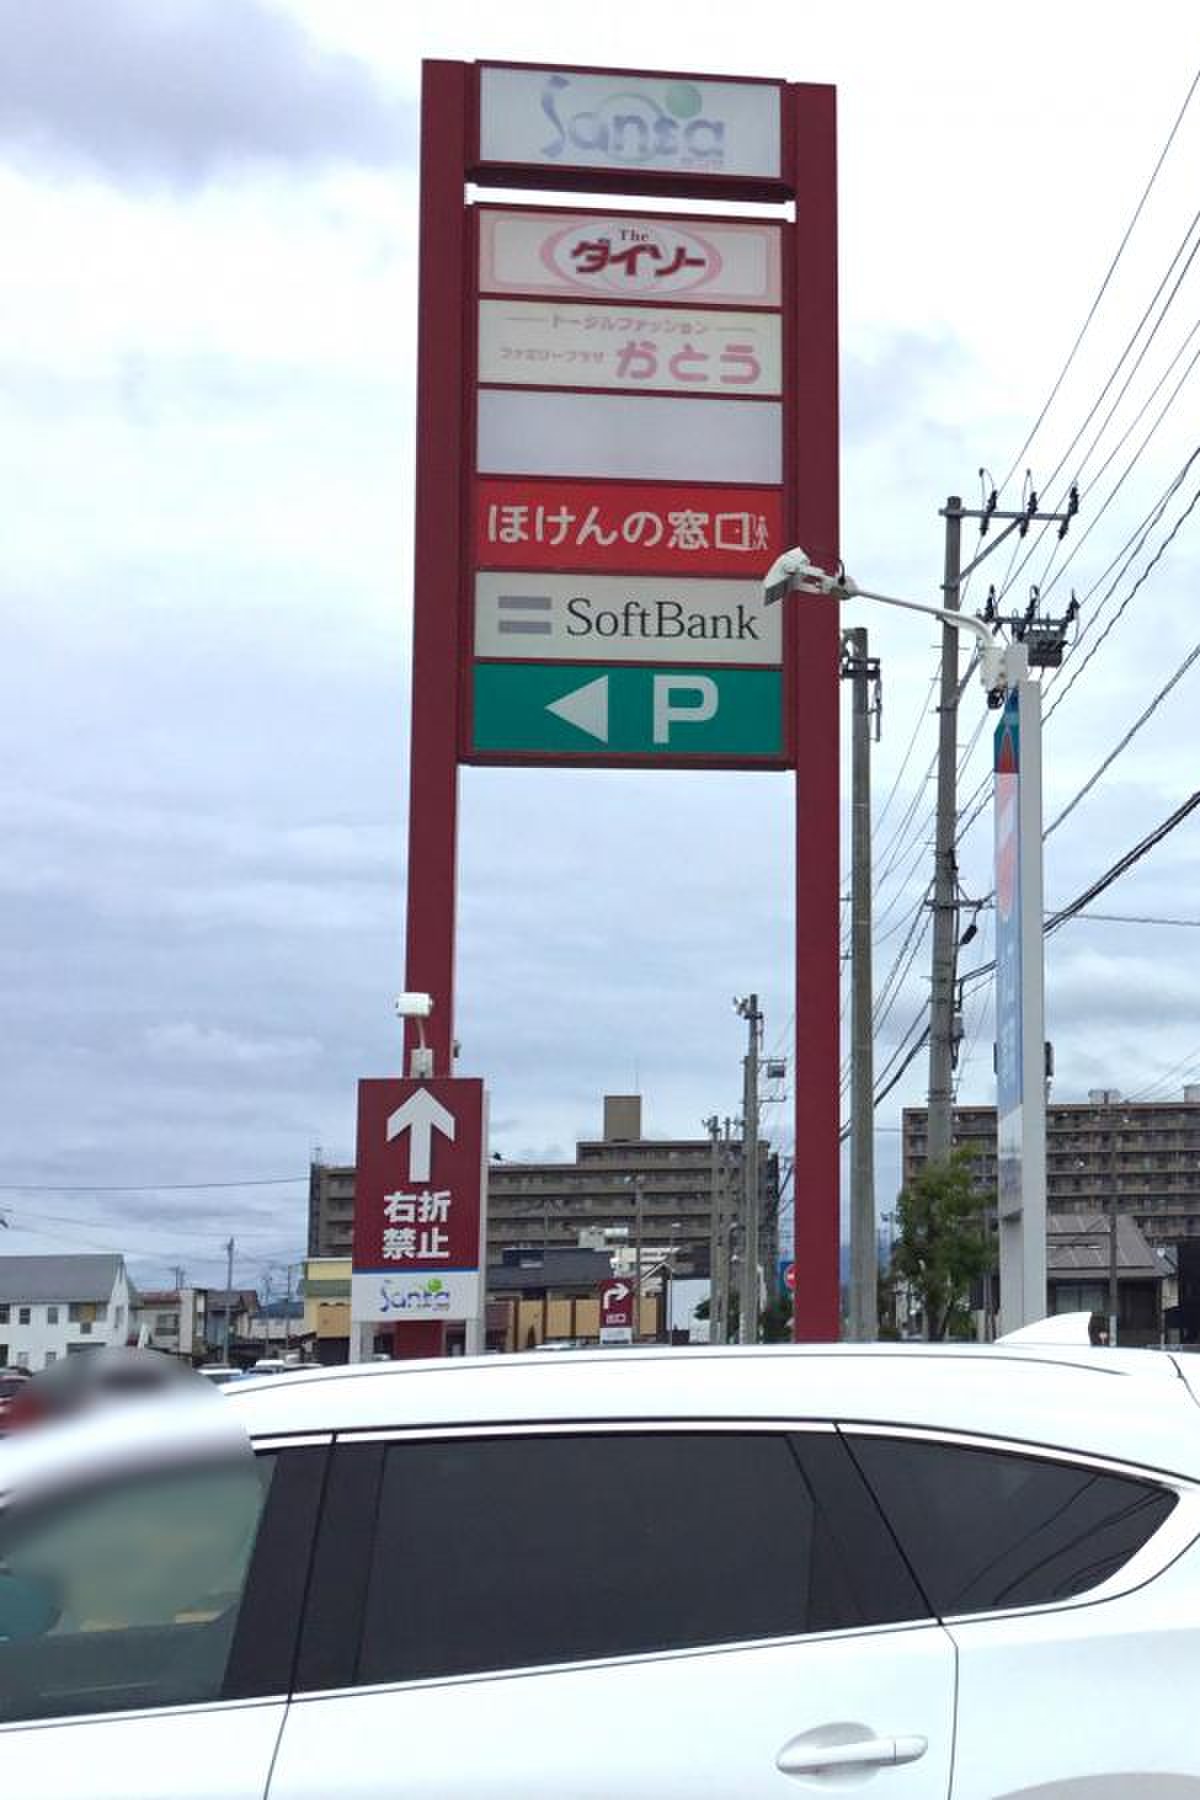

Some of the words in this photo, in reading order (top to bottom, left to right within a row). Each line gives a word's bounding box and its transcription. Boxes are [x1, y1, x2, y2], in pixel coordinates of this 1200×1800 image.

[619, 228, 649, 242] The
[570, 238, 706, 277] ダイソー
[615, 340, 762, 384] かとう
[487, 504, 751, 551] ほけんの窓口
[565, 597, 760, 641] SoftBank
[653, 674, 720, 744] P
[383, 1190, 451, 1224] 右折
[382, 1227, 450, 1260] 禁止
